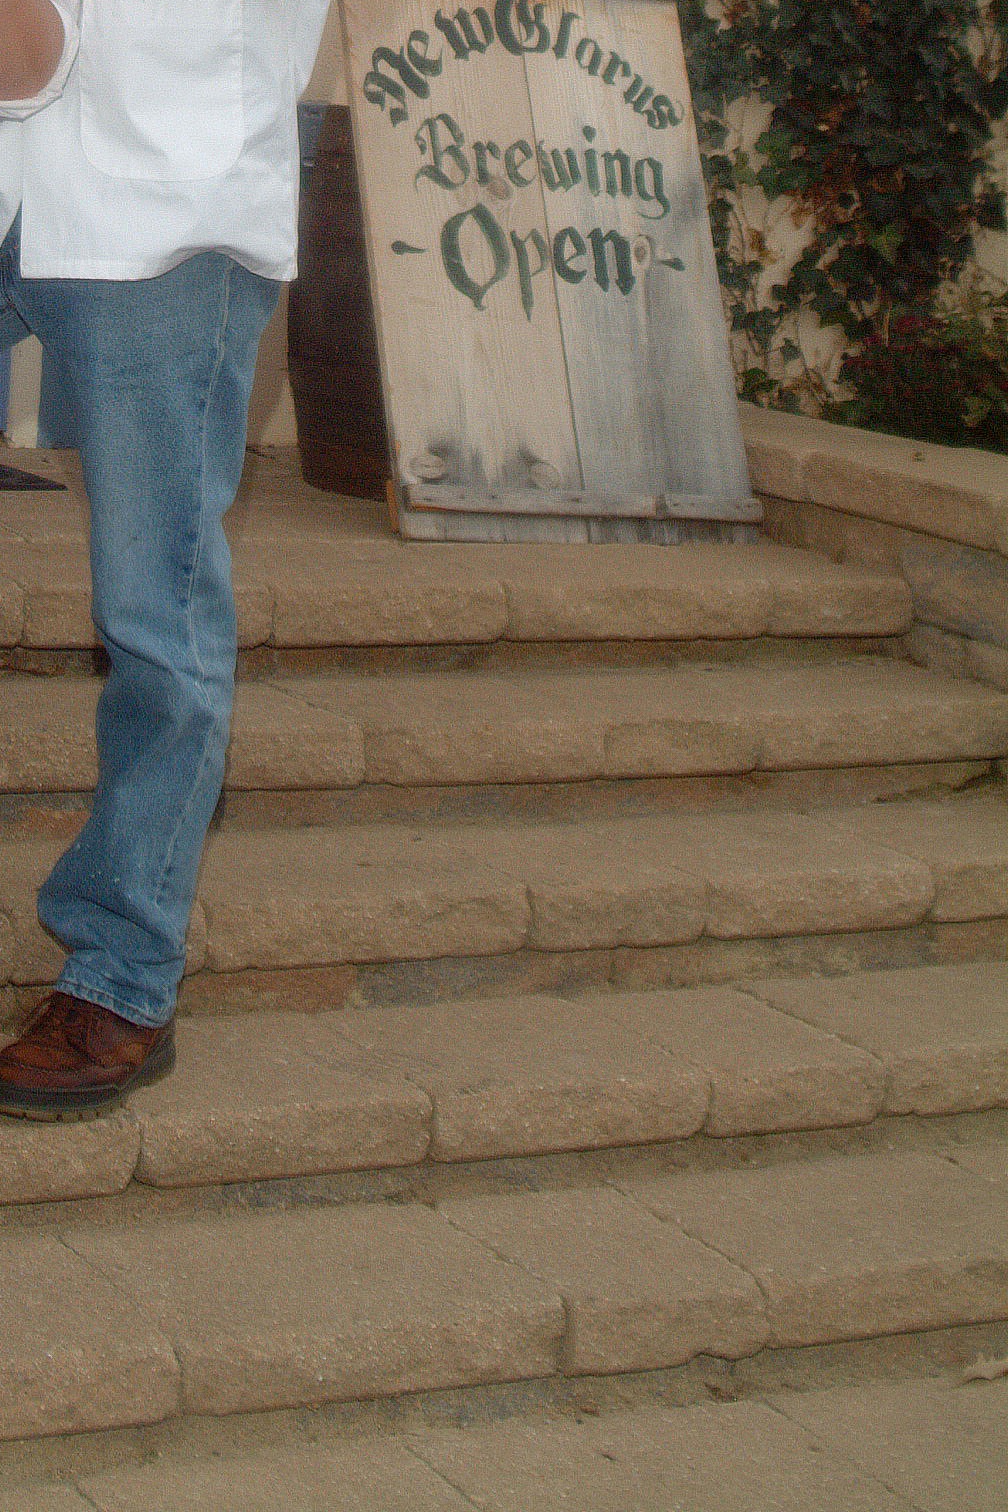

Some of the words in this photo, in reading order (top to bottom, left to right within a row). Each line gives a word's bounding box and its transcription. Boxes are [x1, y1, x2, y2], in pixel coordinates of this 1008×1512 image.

[365, 6, 494, 127] New
[414, 112, 671, 219] Brewing
[441, 202, 637, 322] Open
